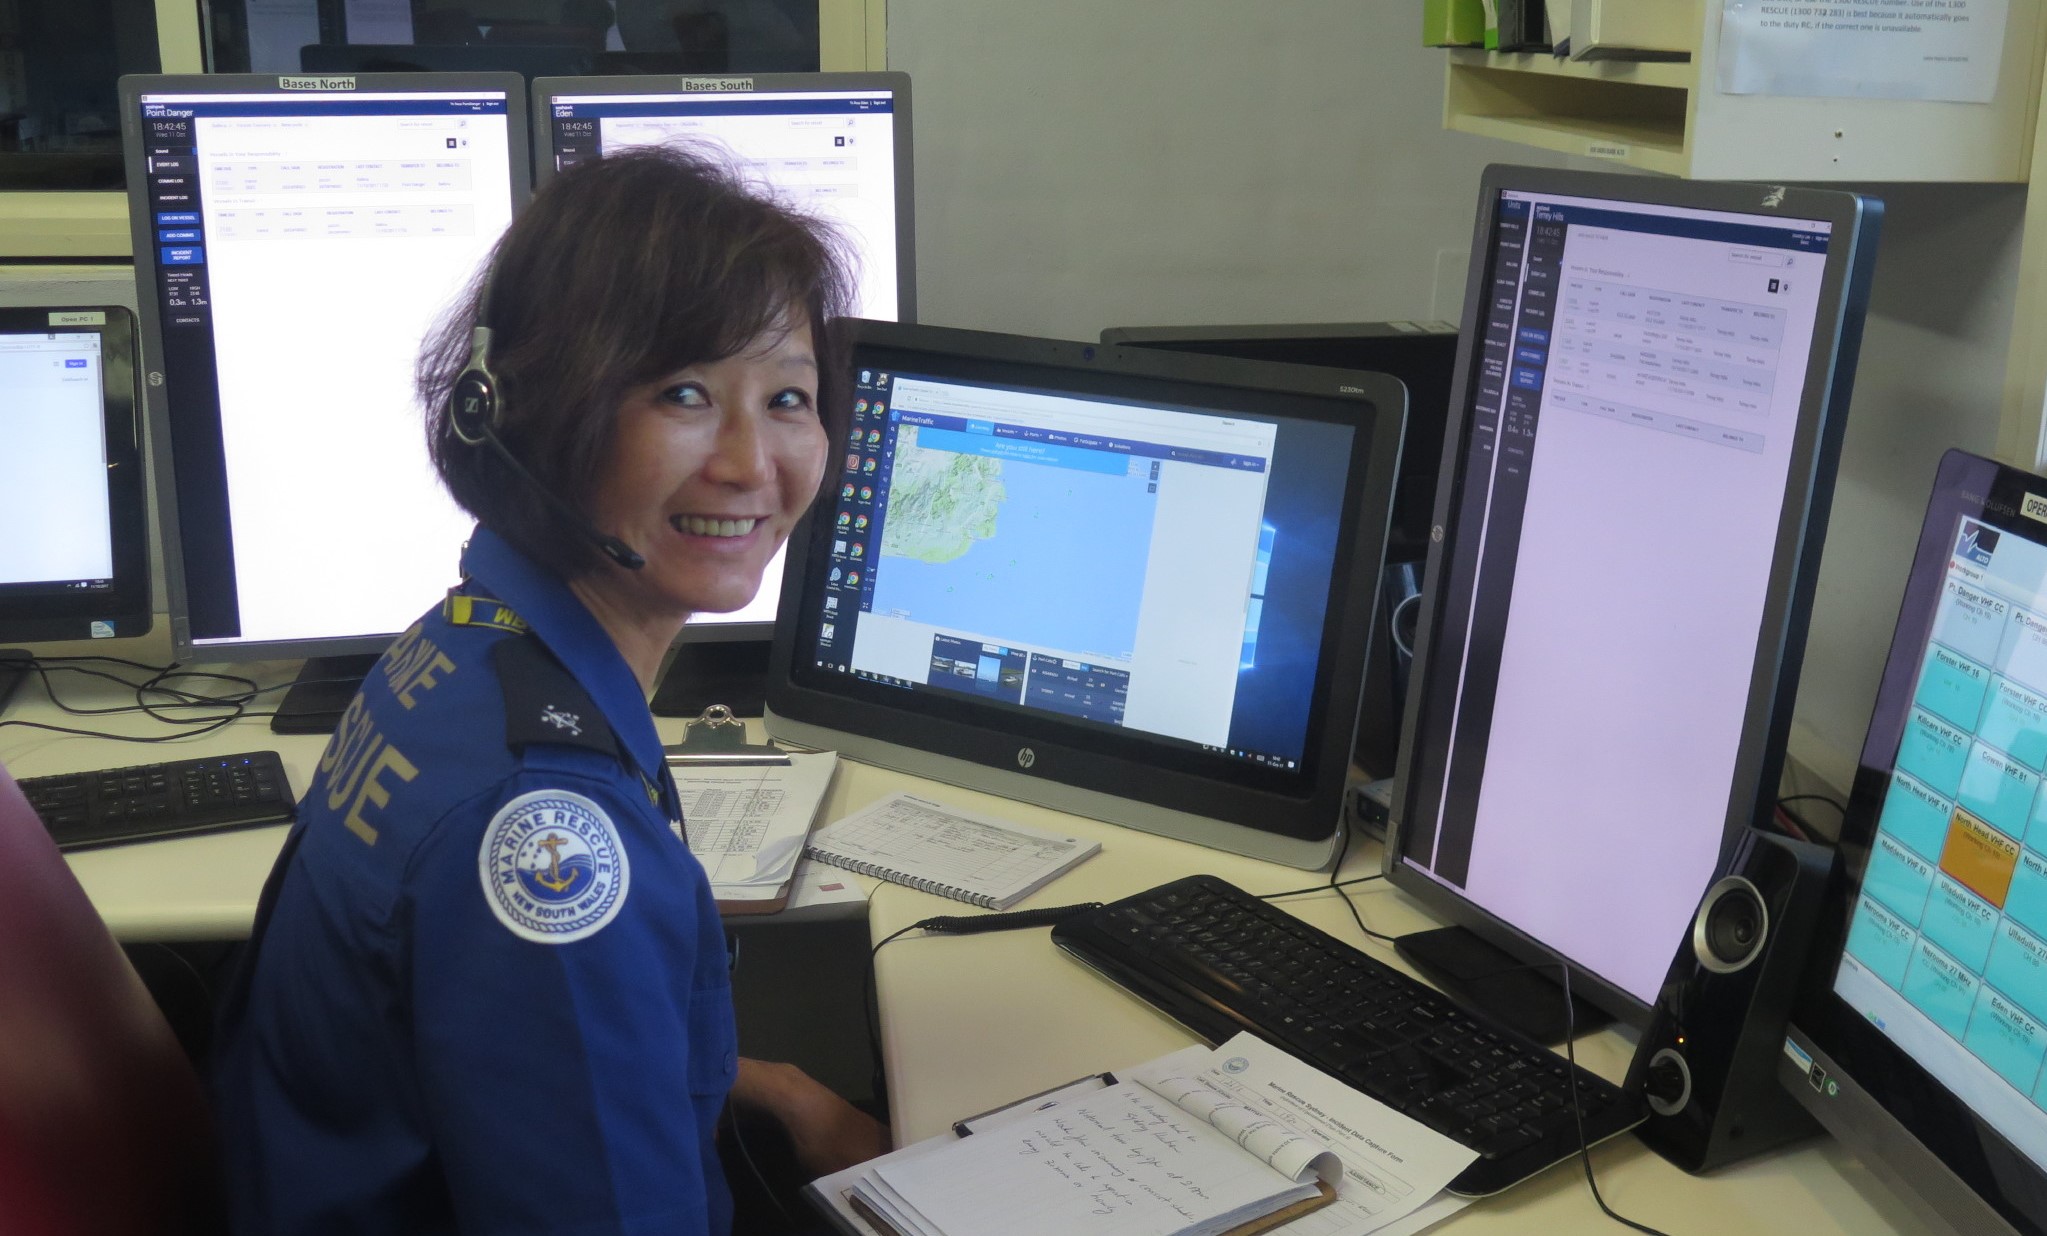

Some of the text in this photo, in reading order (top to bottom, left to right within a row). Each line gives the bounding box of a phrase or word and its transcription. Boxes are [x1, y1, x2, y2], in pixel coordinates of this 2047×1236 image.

[1784, 21, 1798, 29] duty
[1904, 13, 1951, 22] automatically
[282, 78, 355, 90] Bases North
[685, 79, 753, 91] Bases South
[146, 109, 193, 118] Point Danger
[555, 109, 573, 117] Eden
[153, 122, 187, 131] 18:42:45
[561, 122, 593, 130] 18:42:45
[169, 298, 186, 306] 0.3m
[191, 298, 208, 306] 1.3m
[902, 414, 934, 426] MarineTraffic
[1957, 586, 1979, 602] Danger
[1980, 596, 1993, 606] VHF
[1994, 603, 2004, 612] CC
[1936, 650, 1958, 667] Forster
[1958, 661, 1970, 672] VHF
[1999, 682, 2022, 700] Forster
[2024, 695, 2036, 706] VHF
[1917, 714, 1962, 745] Killcare VHF CC
[1018, 747, 1034, 768] hp
[2004, 763, 2018, 775] VHF
[1896, 775, 1911, 790] North
[1912, 785, 1927, 799] Head
[1927, 795, 1940, 806] VHF
[1955, 812, 2015, 856] North Head VHF CC
[500, 813, 546, 886] MARINE
[554, 811, 611, 873] RESCUE
[1881, 840, 1905, 862] Maddens
[1906, 856, 1918, 868] VHF
[2023, 855, 2042, 874] North
[512, 881, 606, 919] NEW SOUTH WALES
[1941, 880, 1992, 921] Ulladulla VHF CC
[1889, 917, 1901, 931] VHF
[1900, 927, 1910, 940] CC
[2008, 926, 2037, 954] Ulladulla
[1949, 964, 1957, 976] 27
[1958, 971, 1972, 988] MHz
[1991, 997, 2035, 1036] Eden VHF CC
[1268, 1082, 1286, 1095] Marine
[1286, 1091, 1305, 1106] Rescue
[1305, 1103, 1326, 1118] Sydney
[1329, 1117, 1352, 1133] Incident
[1351, 1131, 1365, 1142] Data
[1365, 1138, 1388, 1155] Capture
[1387, 1152, 1404, 1164] Form
